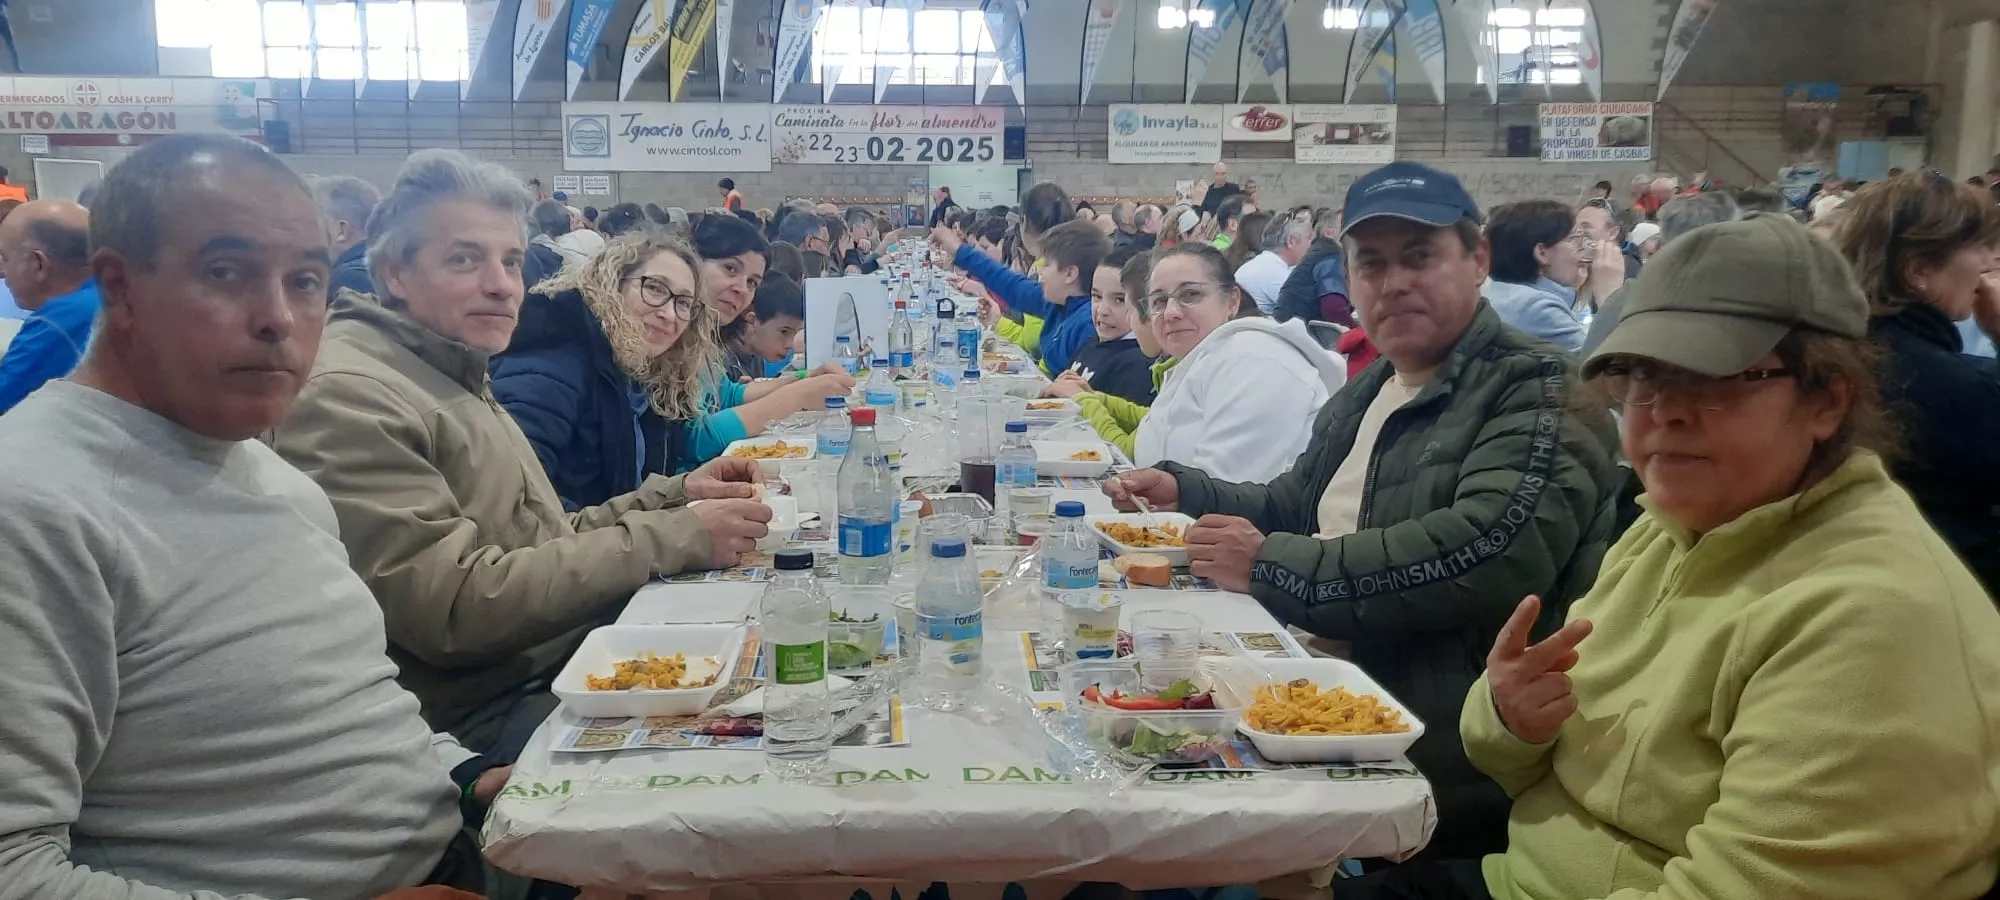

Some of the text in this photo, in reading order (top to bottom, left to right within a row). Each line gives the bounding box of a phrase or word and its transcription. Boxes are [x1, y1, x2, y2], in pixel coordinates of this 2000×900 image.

[573, 4, 597, 42] TUMASA
[634, 31, 661, 64] CARLOS
[108, 96, 133, 104] CASH
[135, 96, 142, 104] &
[144, 96, 174, 104] CARRY
[1541, 103, 1650, 114] PLATAFORMA CIUDADANA
[774, 112, 845, 128] Caminata
[870, 111, 903, 132] flor
[921, 111, 996, 129] almendro
[1142, 115, 1199, 132] Invayla
[1541, 116, 1597, 127] EN DEFENSA
[618, 113, 683, 143] Ignacio
[1556, 128, 1581, 137] DE LA
[809, 134, 833, 151] 22
[1114, 141, 1149, 149] ALQUILER
[1541, 138, 1594, 148] PROPIEDAD
[646, 146, 741, 156] www.cintosl.com
[1542, 148, 1650, 159] DE LA VIRGEN DE CASBAS
[647, 774, 760, 787] DAM
